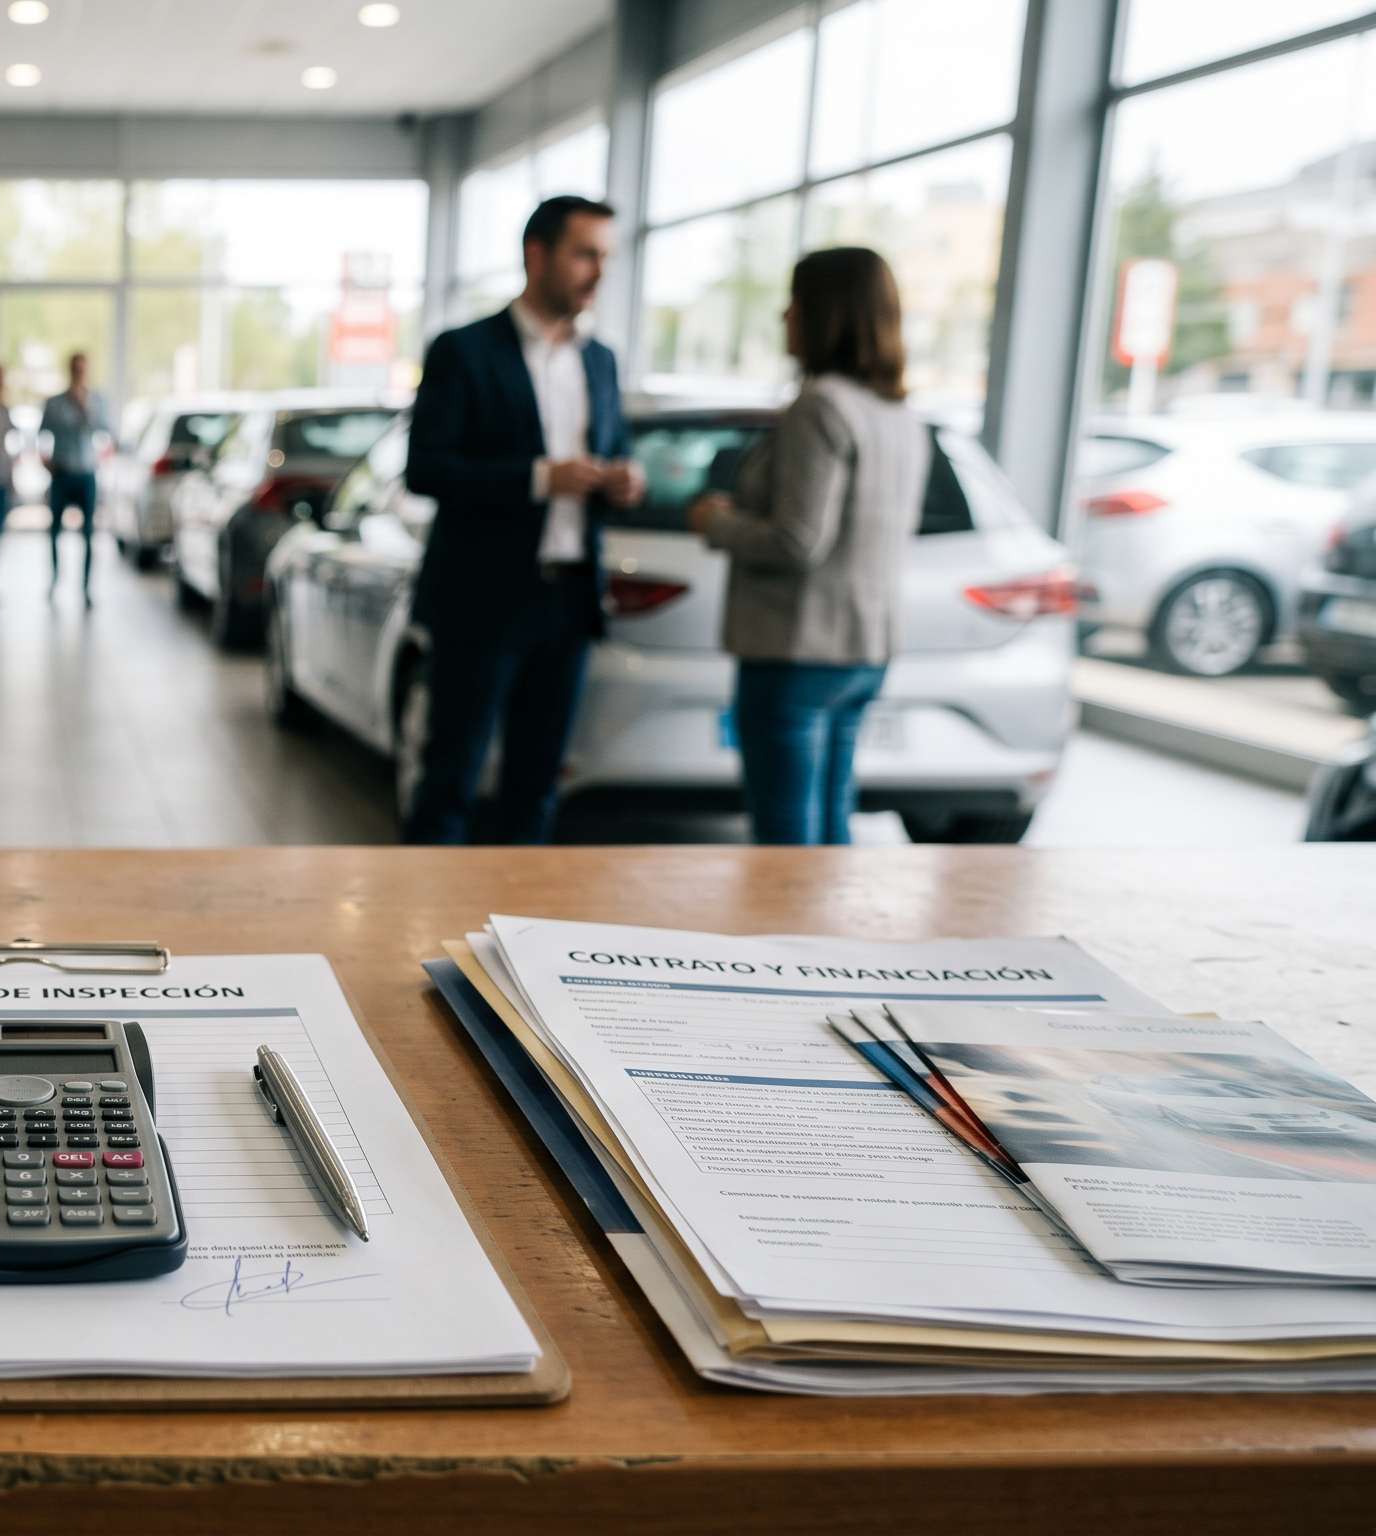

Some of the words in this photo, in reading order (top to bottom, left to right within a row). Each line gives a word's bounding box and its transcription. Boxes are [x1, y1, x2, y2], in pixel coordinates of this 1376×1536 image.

[568, 951, 756, 975] CONTRATO
[762, 963, 784, 976] Y
[796, 965, 1054, 982] FINANCIACIÓN
[42, 983, 245, 999] INSPECCIÓN
[21, 1190, 33, 1198] 3
